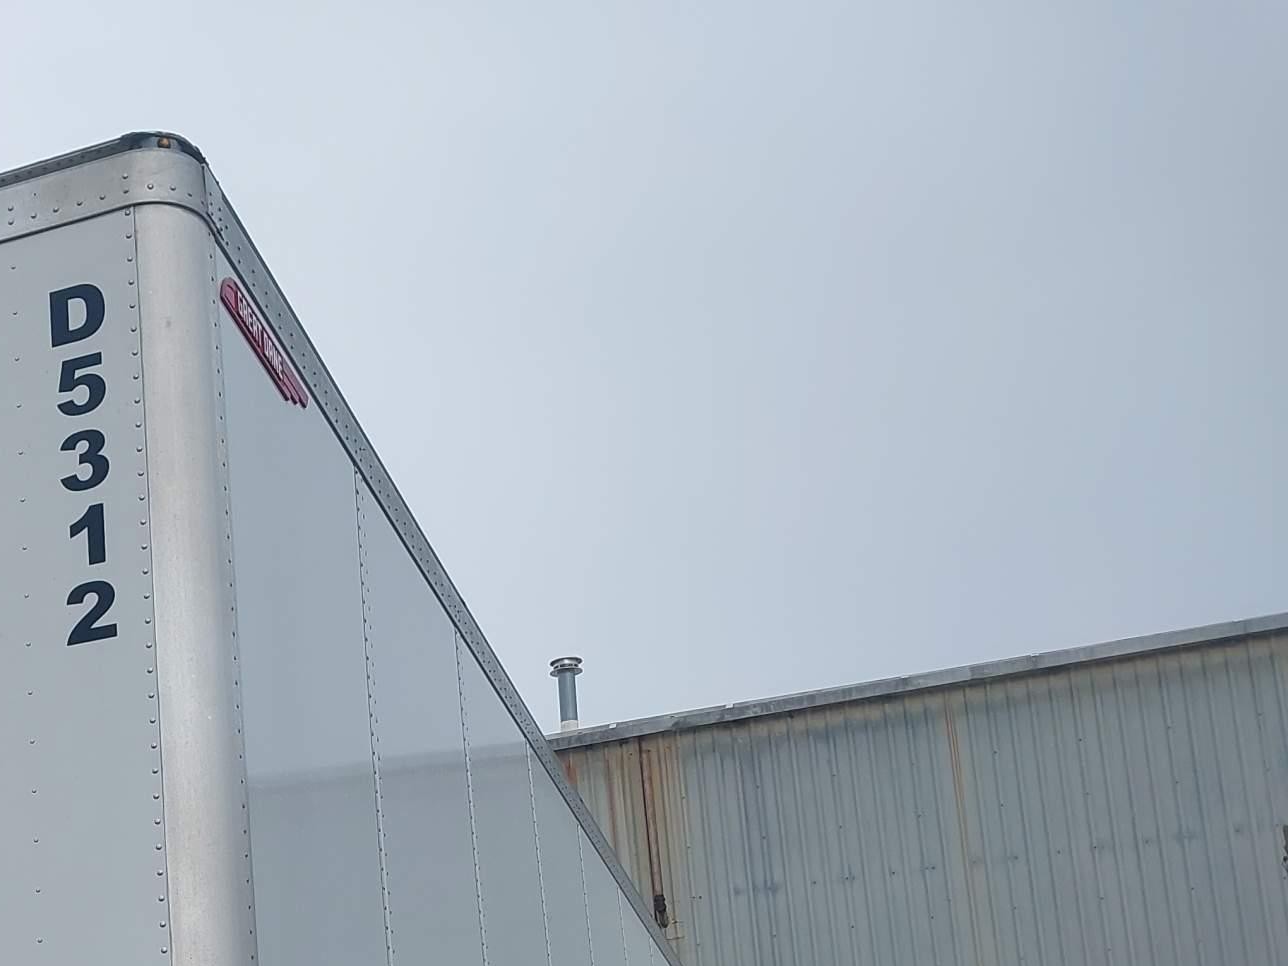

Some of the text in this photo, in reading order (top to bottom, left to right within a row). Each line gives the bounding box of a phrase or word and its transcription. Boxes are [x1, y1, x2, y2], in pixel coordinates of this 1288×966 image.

[237, 290, 284, 382] GREAT DANE
[49, 283, 118, 646] D5312
